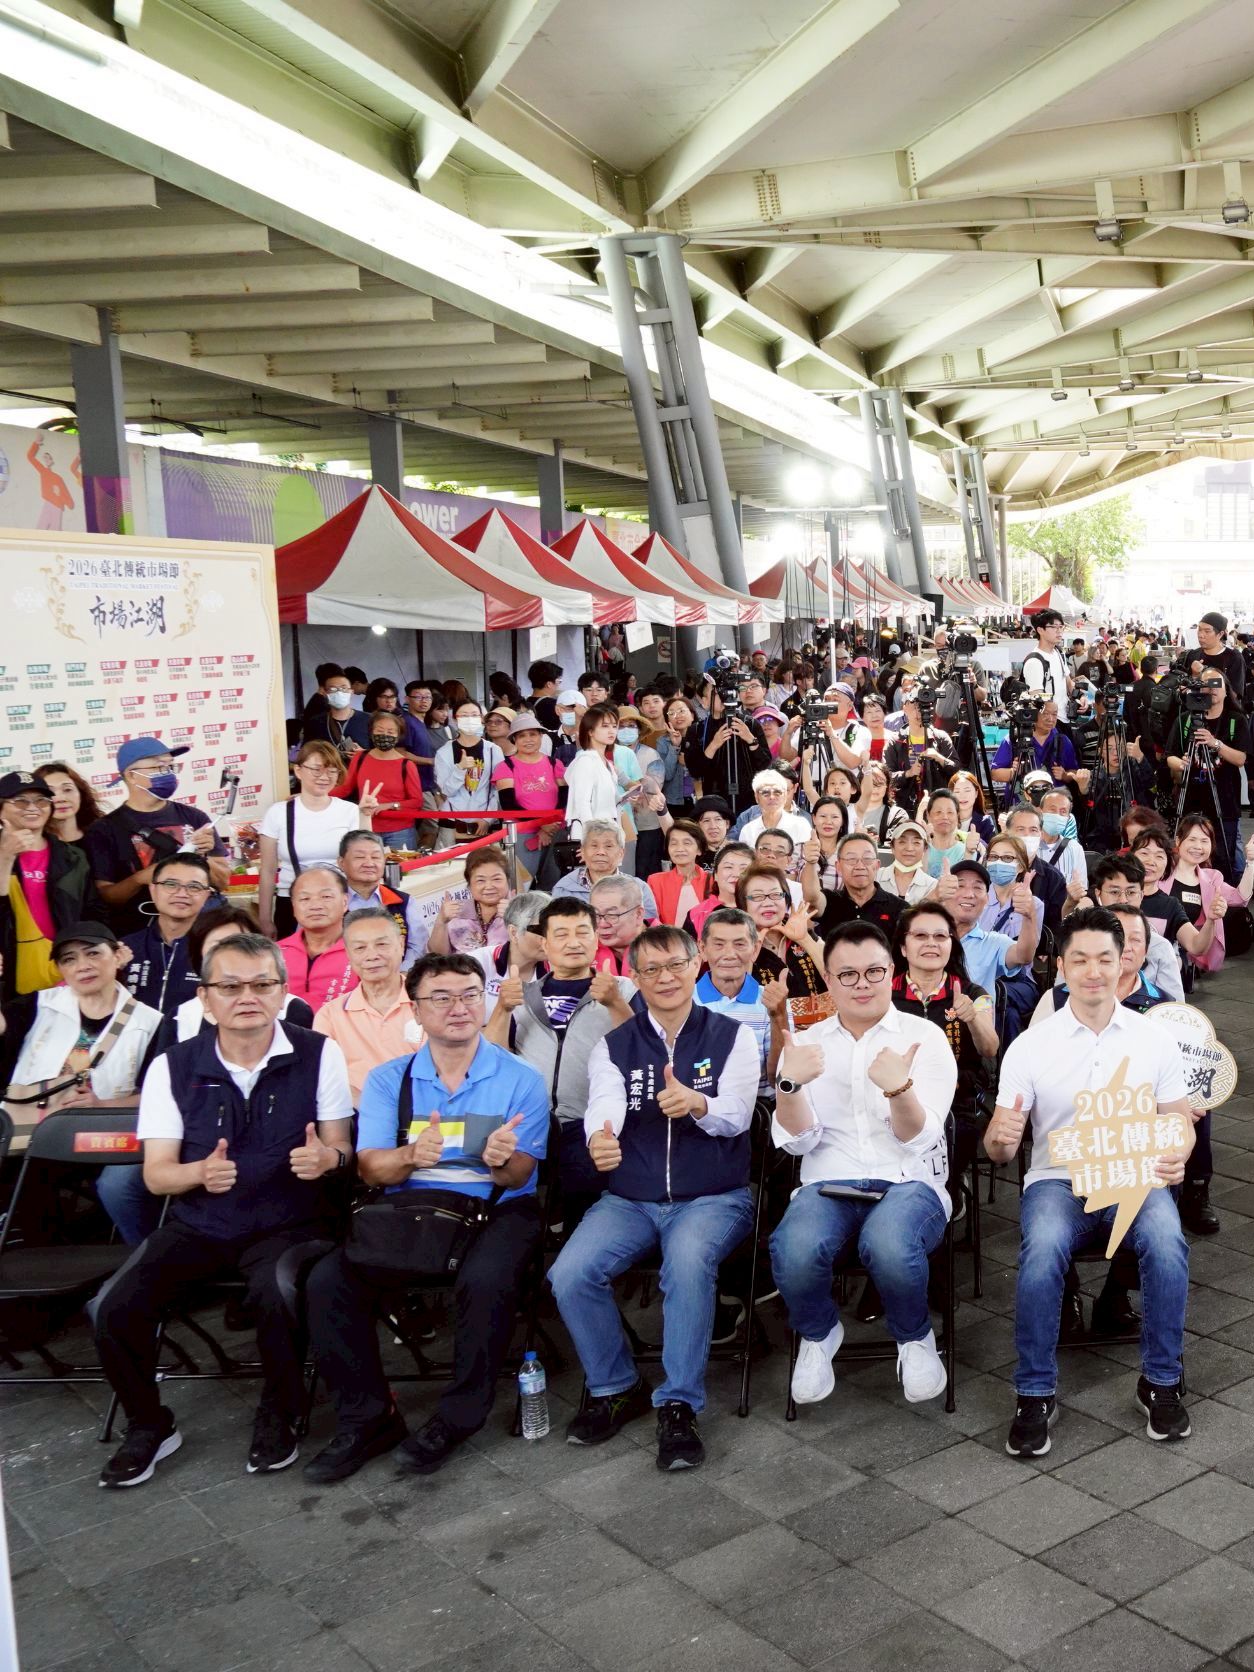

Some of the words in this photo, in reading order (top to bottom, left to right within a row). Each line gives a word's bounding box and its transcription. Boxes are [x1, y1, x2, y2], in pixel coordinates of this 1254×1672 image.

[408, 502, 459, 533] ower
[68, 559, 97, 576] 2026
[88, 595, 166, 639] 市場江湖
[628, 1068, 644, 1111] 黃宏光
[692, 1075, 713, 1085] TAIPEI
[1183, 1066, 1217, 1099] 湖
[1077, 1086, 1154, 1122] 2026
[1052, 1117, 1185, 1161] 臺北傳統
